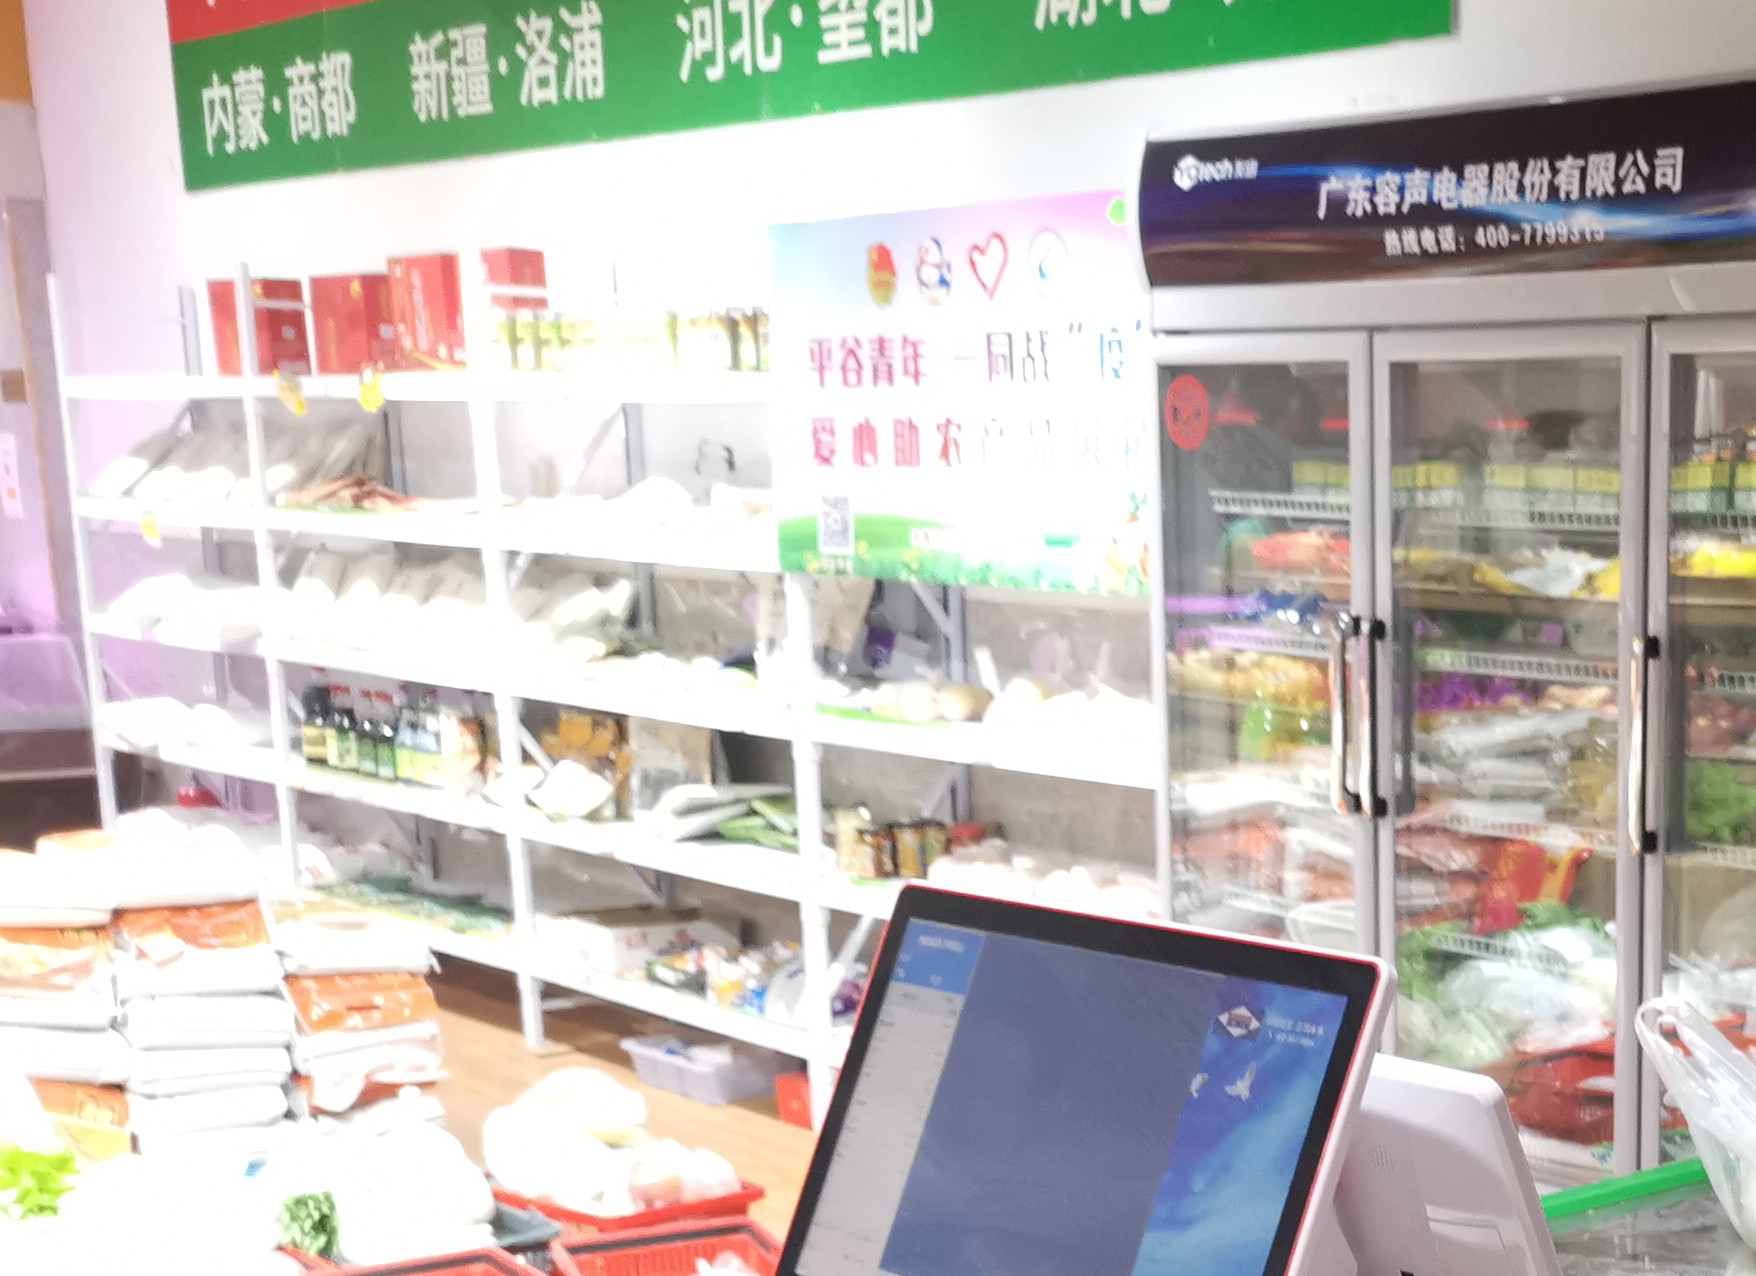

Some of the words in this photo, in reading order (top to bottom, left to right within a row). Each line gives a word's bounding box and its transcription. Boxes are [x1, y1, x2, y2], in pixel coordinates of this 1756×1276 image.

[202, 51, 357, 157] 内蒙·商都
[409, 0, 606, 122] 新疆·洛浦
[1317, 147, 1685, 221] 广东容声电器股份有限公司
[809, 334, 926, 388] 平谷青年
